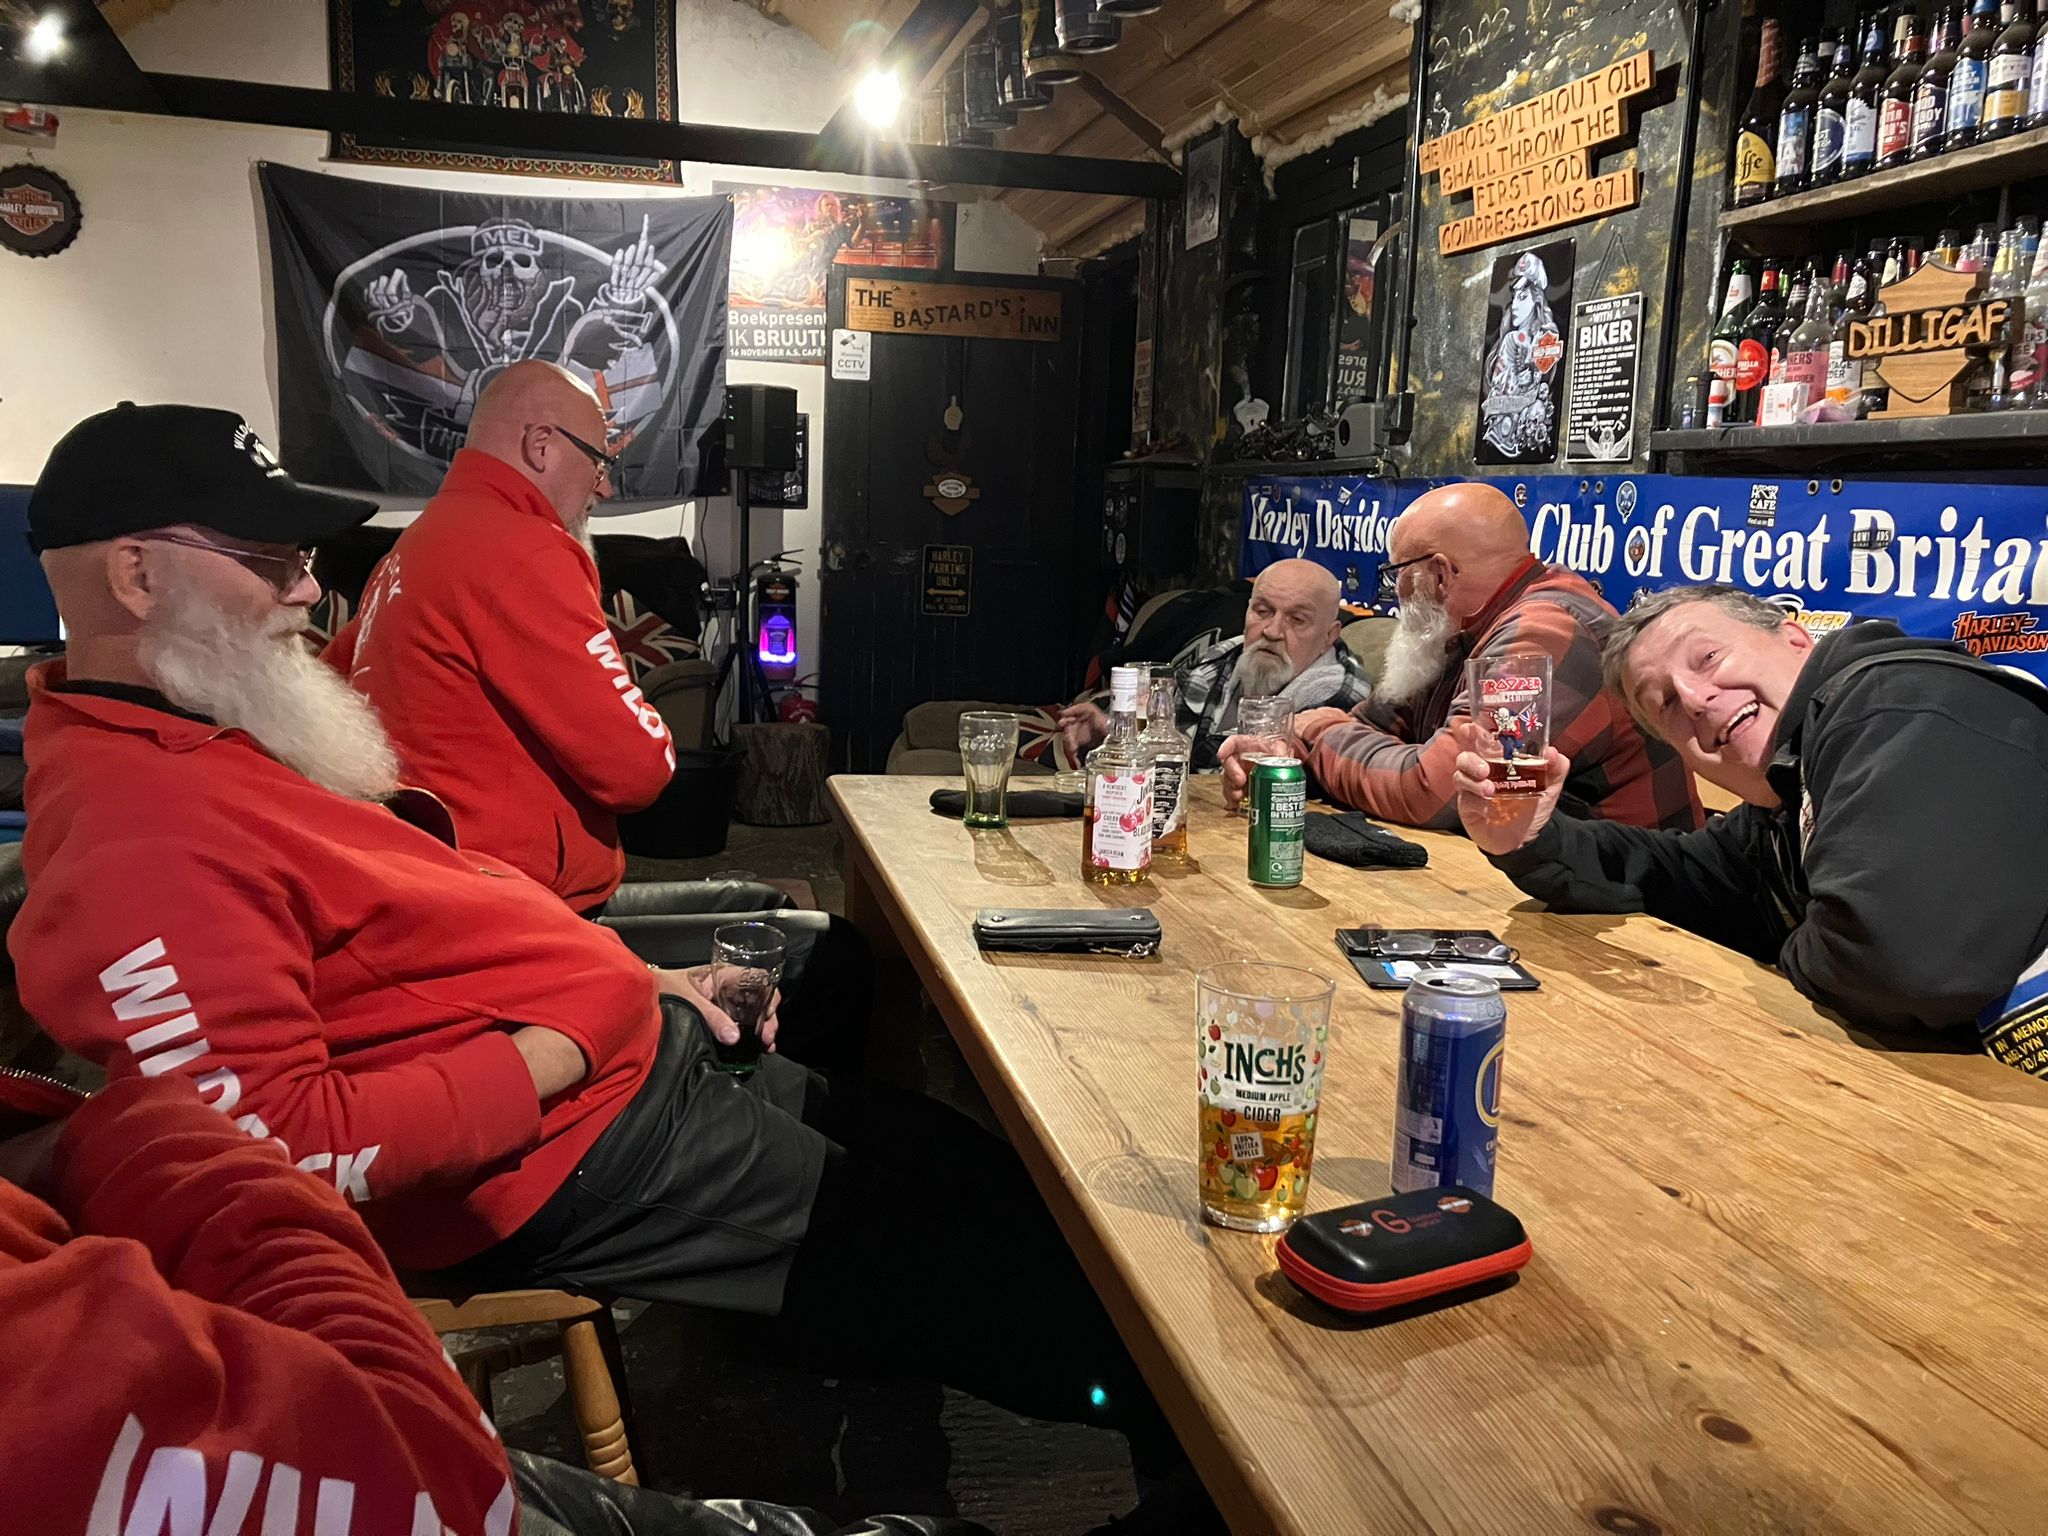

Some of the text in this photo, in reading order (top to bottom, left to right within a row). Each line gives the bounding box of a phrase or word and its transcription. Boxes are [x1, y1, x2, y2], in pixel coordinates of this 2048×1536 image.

[1422, 143, 1440, 168] HE
[1500, 76, 1601, 135] WITHOUT
[1607, 58, 1646, 94] OIL
[1442, 105, 1616, 191] SHALL THROW THE
[1740, 150, 1763, 180] ffe
[1476, 154, 1583, 211] FIRST ROD
[1442, 187, 1586, 249] COMPRESSIONS
[481, 229, 535, 249] MEL
[855, 288, 893, 308] THE
[893, 299, 1011, 328] BASTARD'S
[1593, 311, 1613, 323] WITH
[729, 329, 748, 346] IK
[1580, 319, 1633, 350] BIKER
[1849, 301, 2008, 358] DILLIGAF
[730, 348, 739, 356] 16
[740, 348, 784, 356] NOVEMBER
[838, 359, 865, 368] CCTV
[1750, 499, 1776, 510] CAFE
[1248, 492, 1310, 559] Harley
[1316, 499, 1399, 554] Davidso
[1530, 503, 1615, 574] Club
[1624, 505, 1674, 577] of
[1679, 506, 1831, 592] Great
[932, 550, 963, 562] HARLEY
[929, 563, 966, 575] PARKING
[936, 576, 958, 586] ONLY
[1786, 612, 1846, 631] ARGER
[1966, 634, 2048, 659] DAVIDSON
[1276, 802, 1298, 811] BEST
[1996, 1039, 2009, 1052] IN
[1236, 1089, 1291, 1101] MEDIUM APPLE
[1244, 1106, 1281, 1121] CIDER
